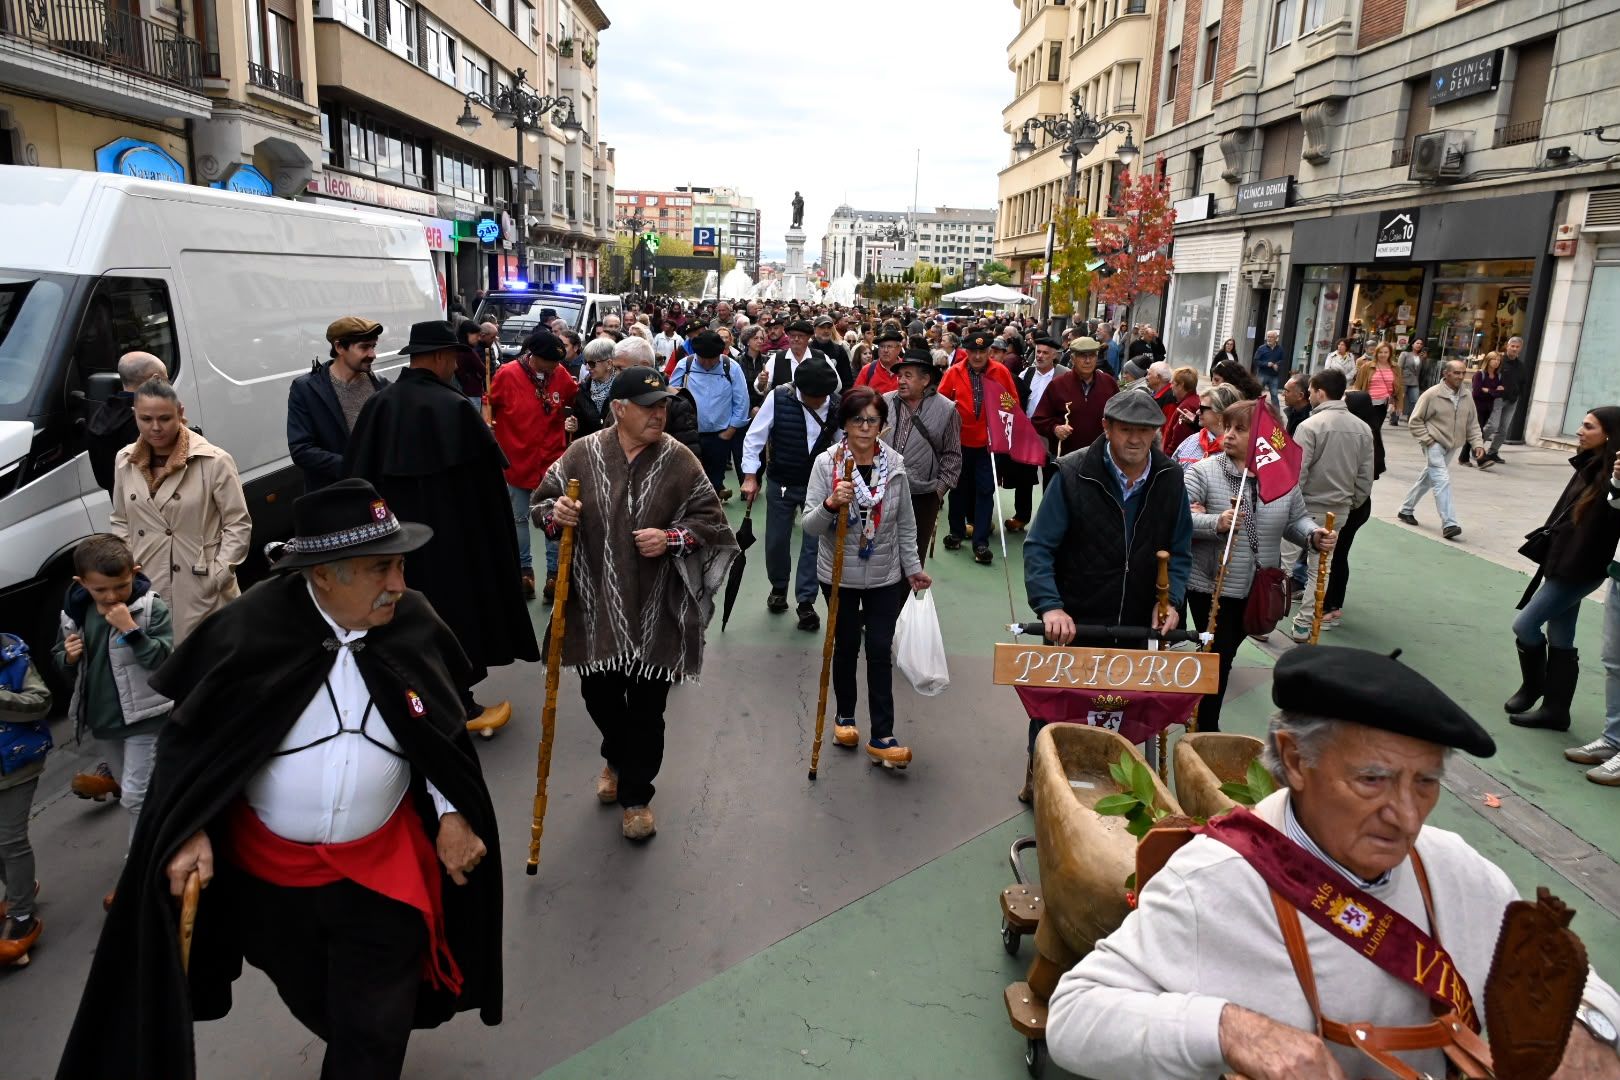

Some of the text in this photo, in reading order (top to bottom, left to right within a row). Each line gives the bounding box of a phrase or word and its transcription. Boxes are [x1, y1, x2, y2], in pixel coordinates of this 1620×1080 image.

[1452, 57, 1492, 79] CLINICA
[1449, 71, 1490, 91] DENTAL
[1243, 182, 1287, 200] CLÍNICA DENTAL
[479, 225, 498, 238] 24h
[699, 229, 710, 245] P
[1402, 224, 1414, 240] 10
[1015, 651, 1202, 689] PRIORO
[1311, 883, 1334, 910] PAÍS
[1363, 913, 1394, 957] LLIONÉS
